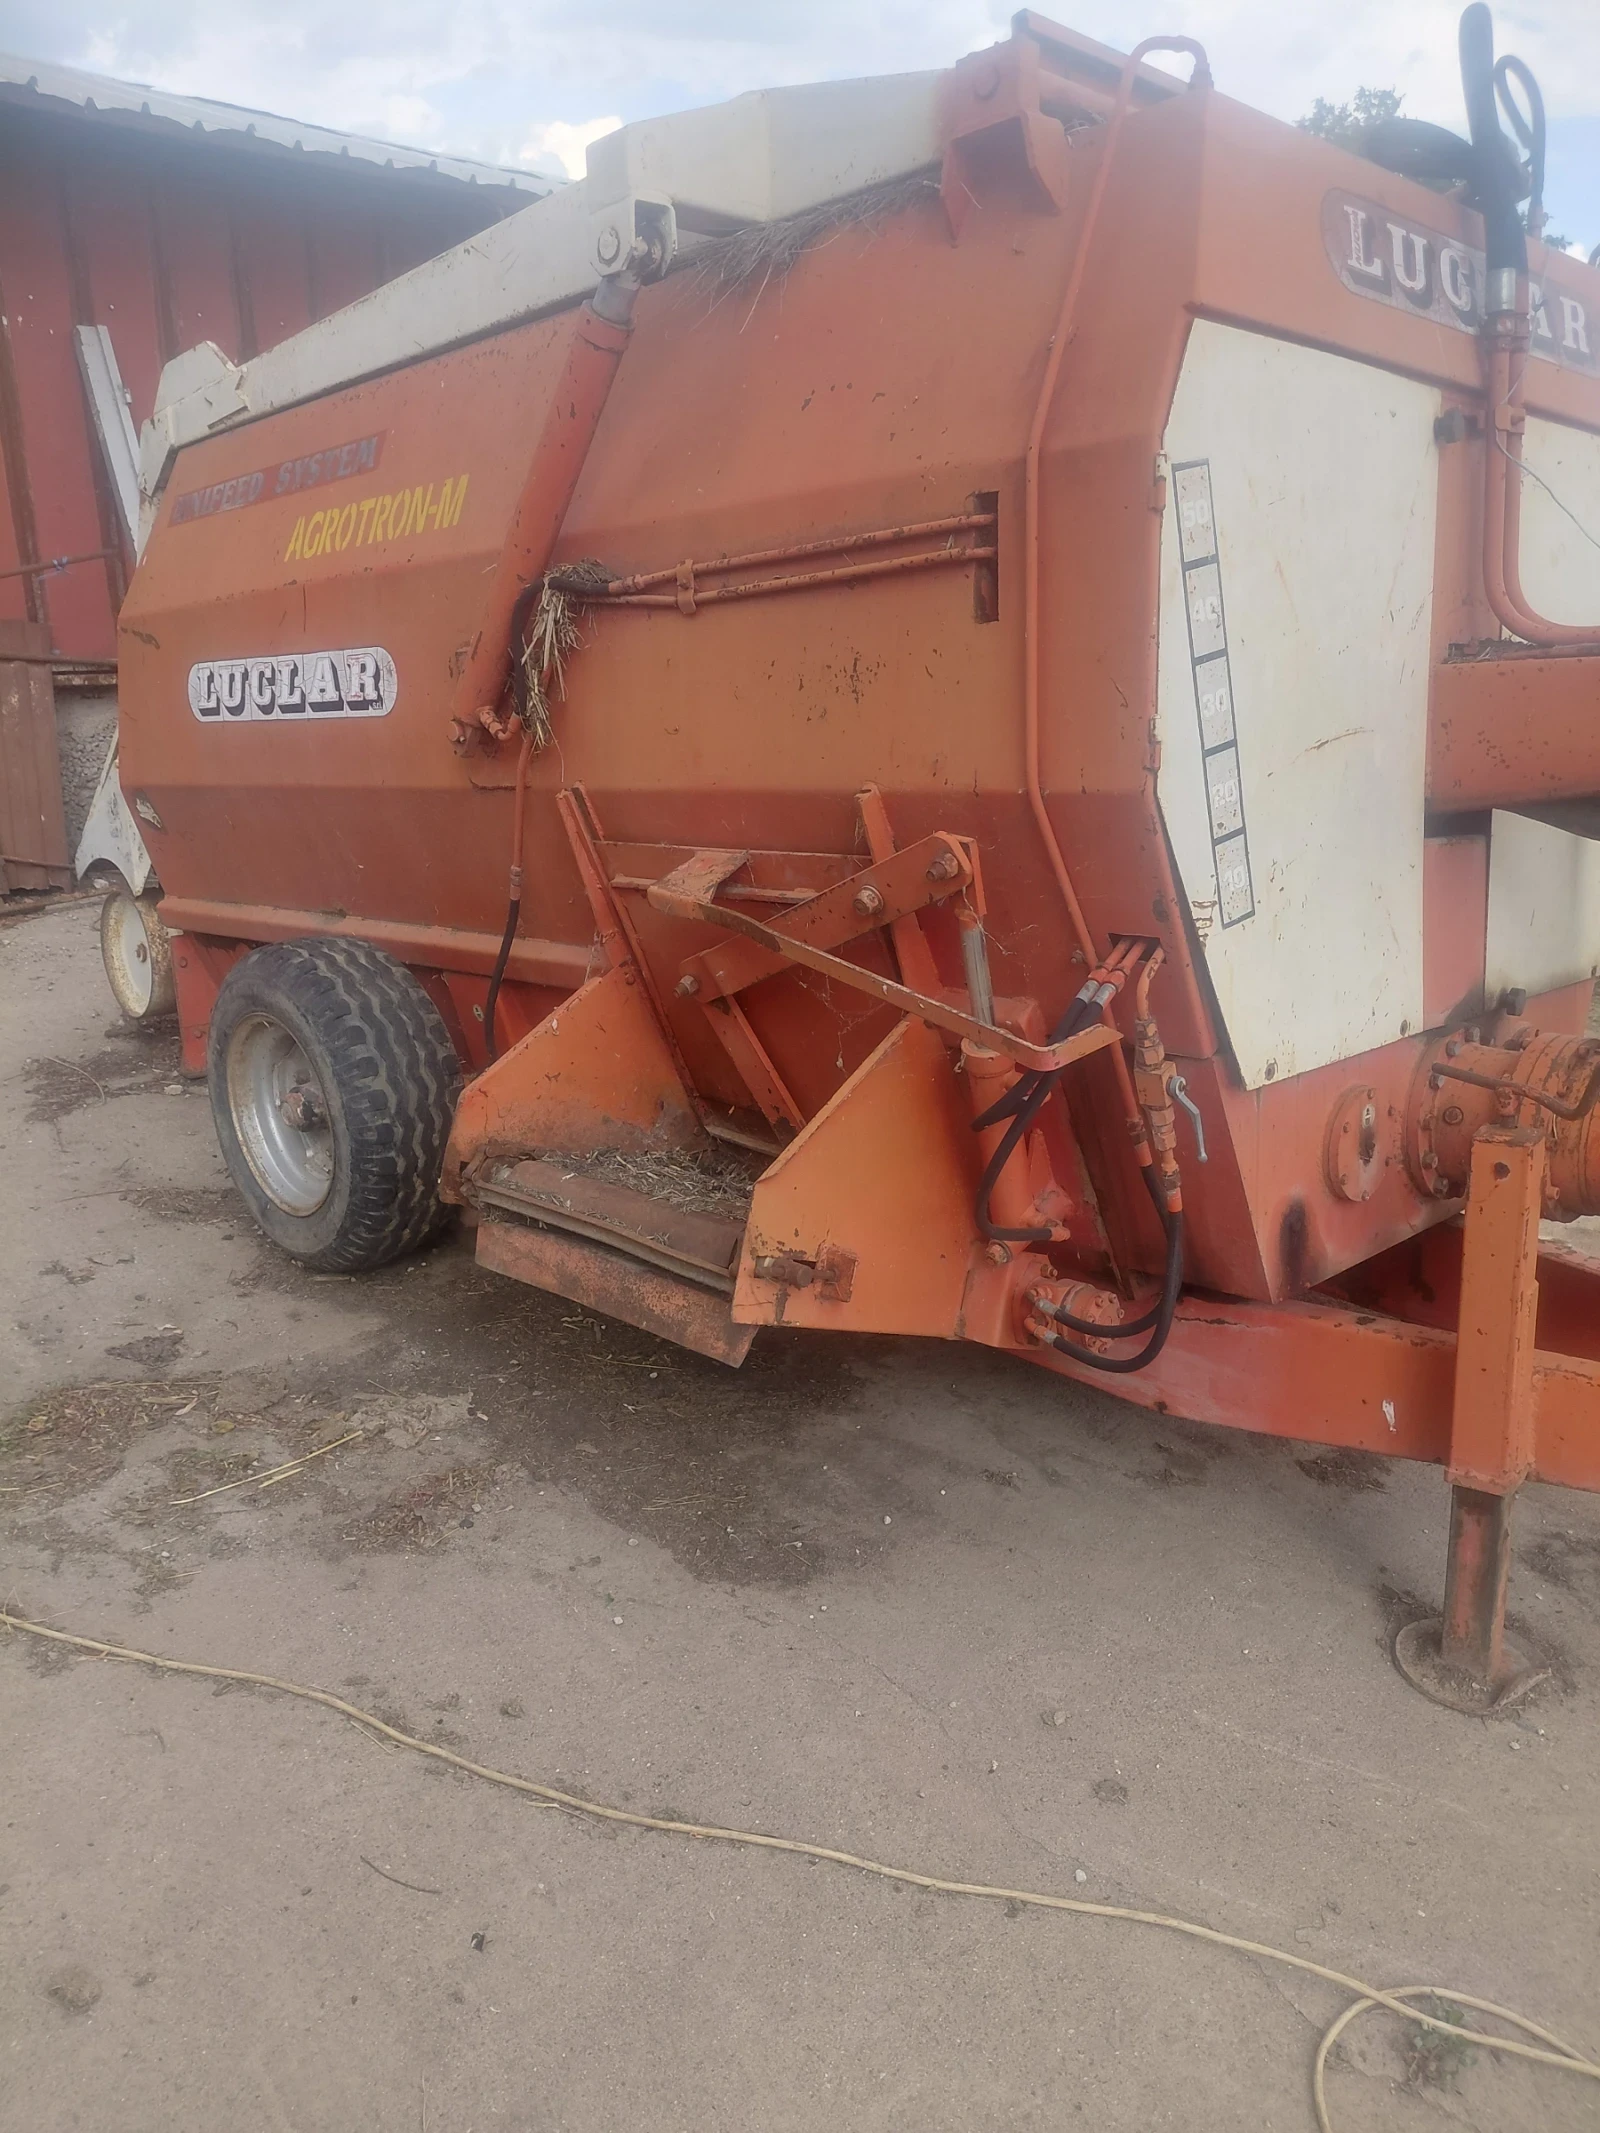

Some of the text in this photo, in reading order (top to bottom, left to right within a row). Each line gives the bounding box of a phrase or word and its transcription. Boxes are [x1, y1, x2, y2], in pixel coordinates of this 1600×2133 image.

[1343, 204, 1589, 354] LUCAR
[274, 436, 378, 494] SYSTEM
[284, 473, 470, 562] AGROTRON-M
[1183, 501, 1210, 527] 50
[1193, 597, 1221, 622] 40
[196, 652, 383, 716] LUCLAR
[1202, 688, 1228, 718] 30
[1212, 779, 1237, 807] 20
[1223, 865, 1246, 890] 10
